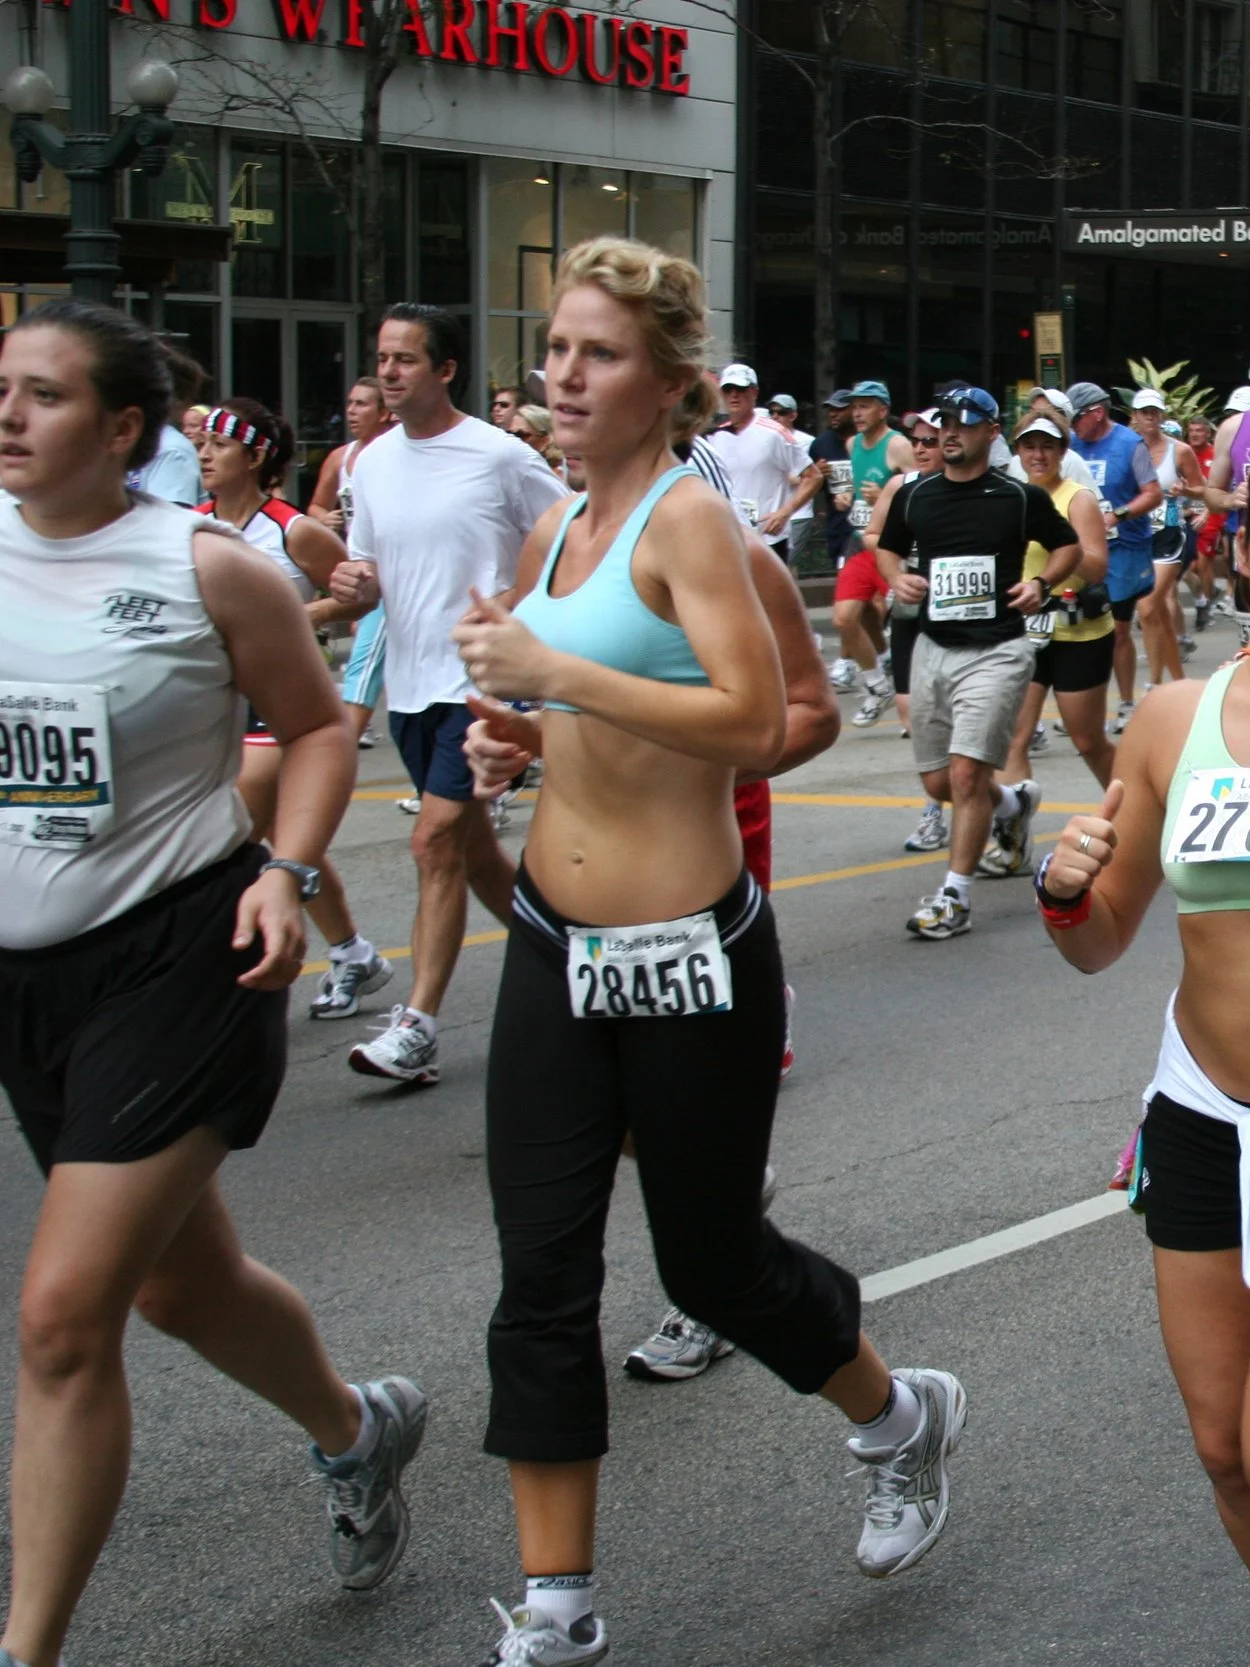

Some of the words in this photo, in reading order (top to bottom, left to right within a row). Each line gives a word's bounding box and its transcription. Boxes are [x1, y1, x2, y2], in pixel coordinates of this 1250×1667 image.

[1077, 219, 1227, 248] Amalgamated
[934, 571, 992, 597] 31999
[107, 605, 161, 623] FEET
[43, 696, 79, 713] Bank
[607, 936, 652, 954] LaSalle
[656, 931, 694, 948] Bank
[577, 952, 717, 1018] 28456
